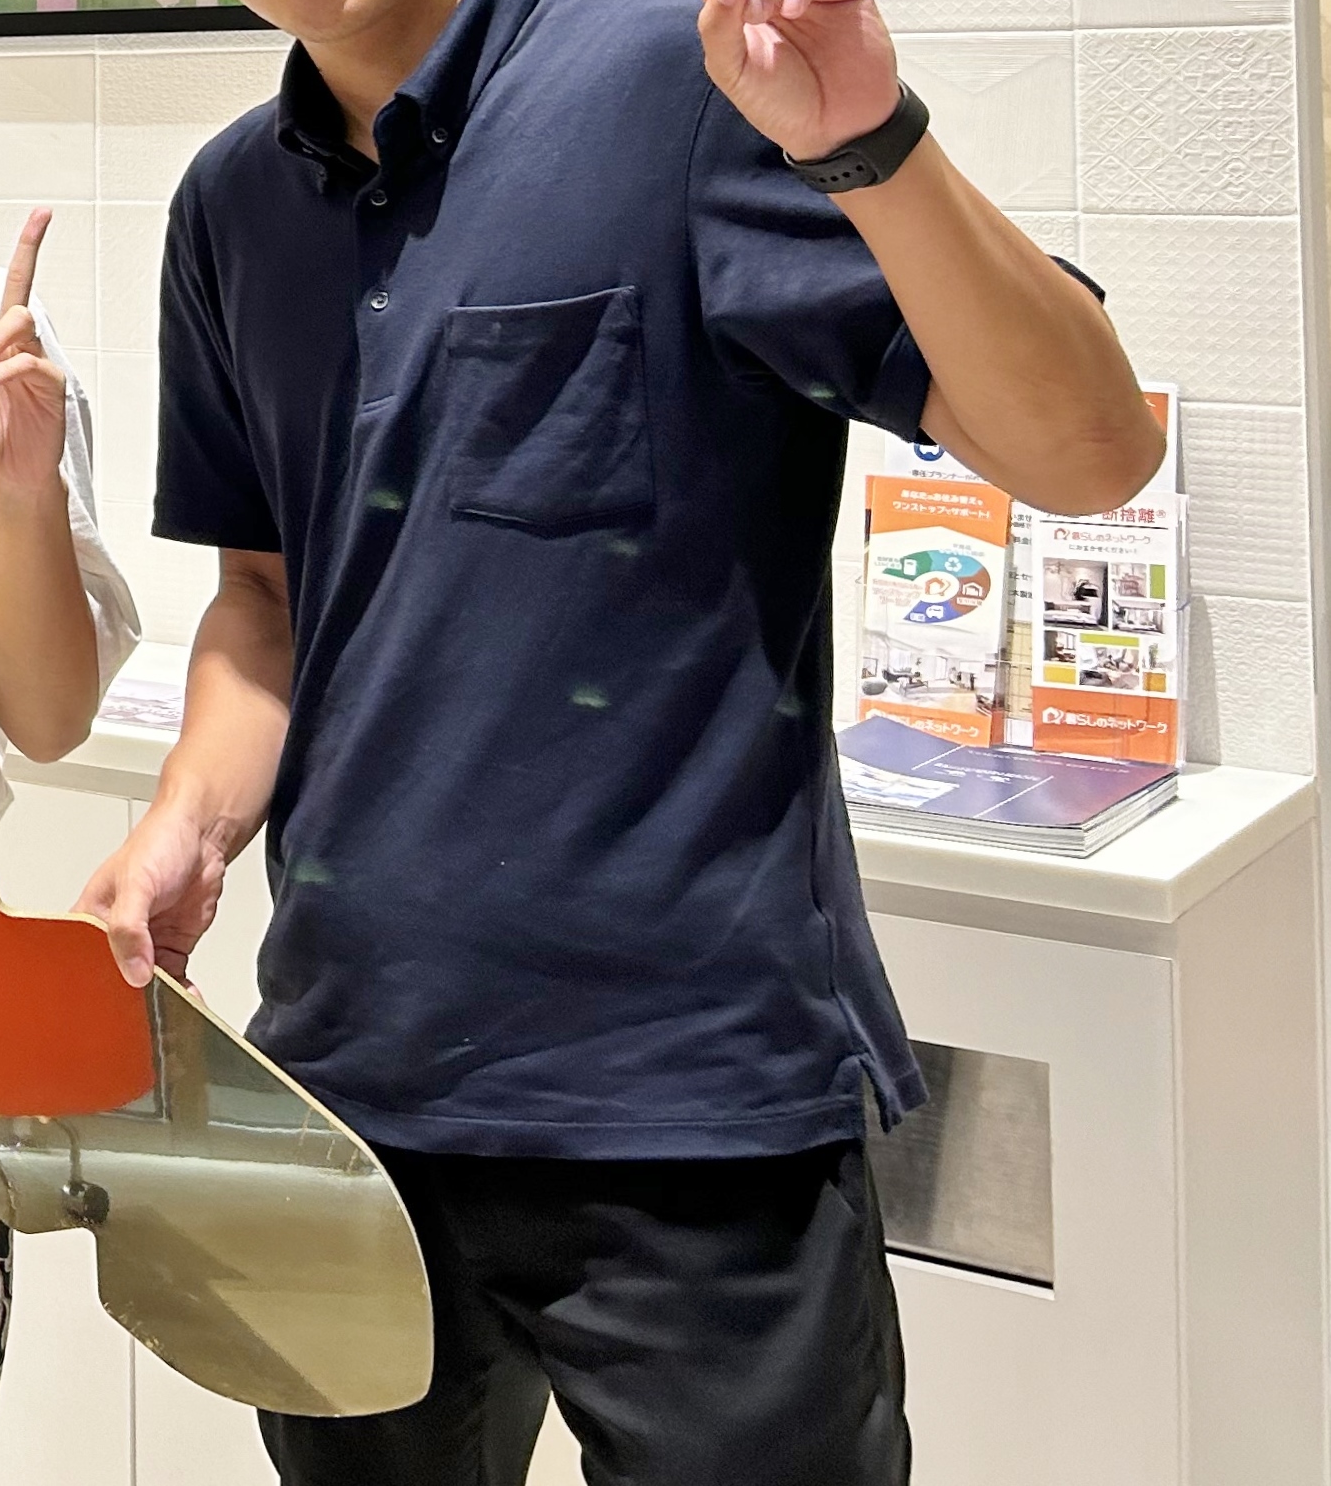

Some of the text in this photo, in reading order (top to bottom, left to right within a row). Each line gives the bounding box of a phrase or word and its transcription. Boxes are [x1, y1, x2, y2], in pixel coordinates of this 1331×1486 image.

[1065, 713, 1168, 734] 暮らしのネットワーク
